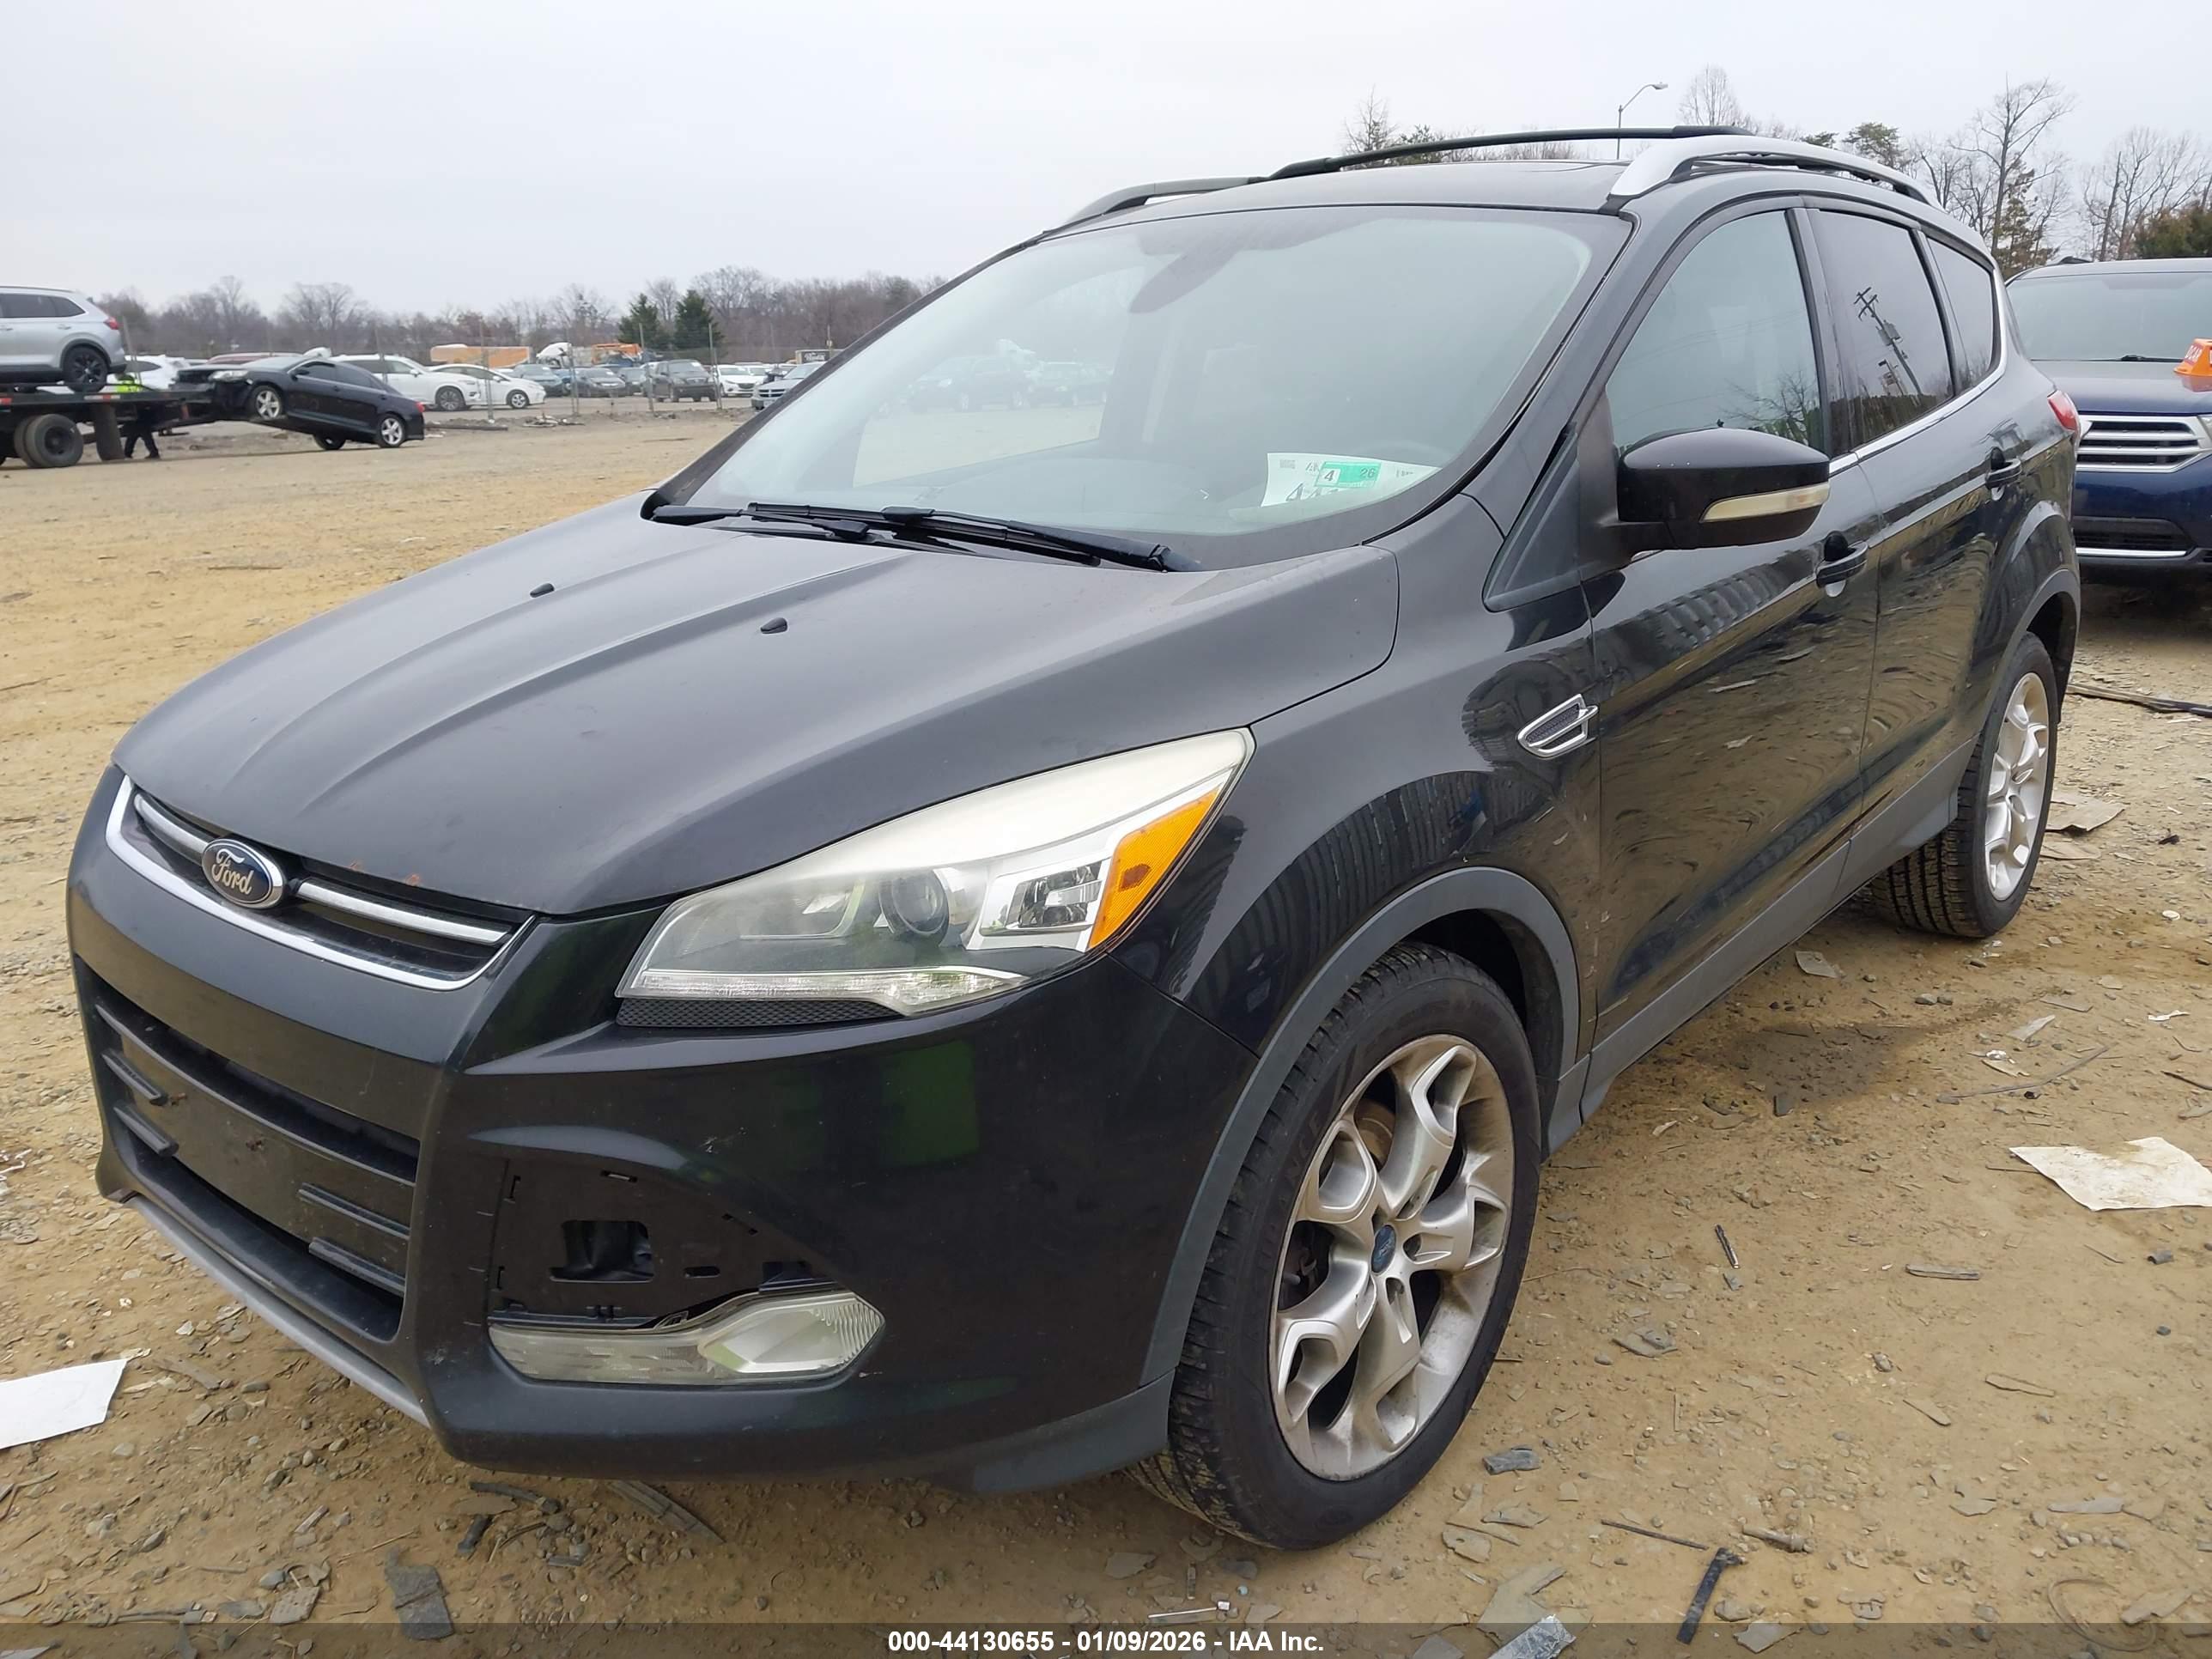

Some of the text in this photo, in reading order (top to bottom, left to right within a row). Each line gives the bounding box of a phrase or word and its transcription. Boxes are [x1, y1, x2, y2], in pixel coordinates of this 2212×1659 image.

[1324, 467, 1376, 482] 4 26
[210, 848, 254, 896] Ford
